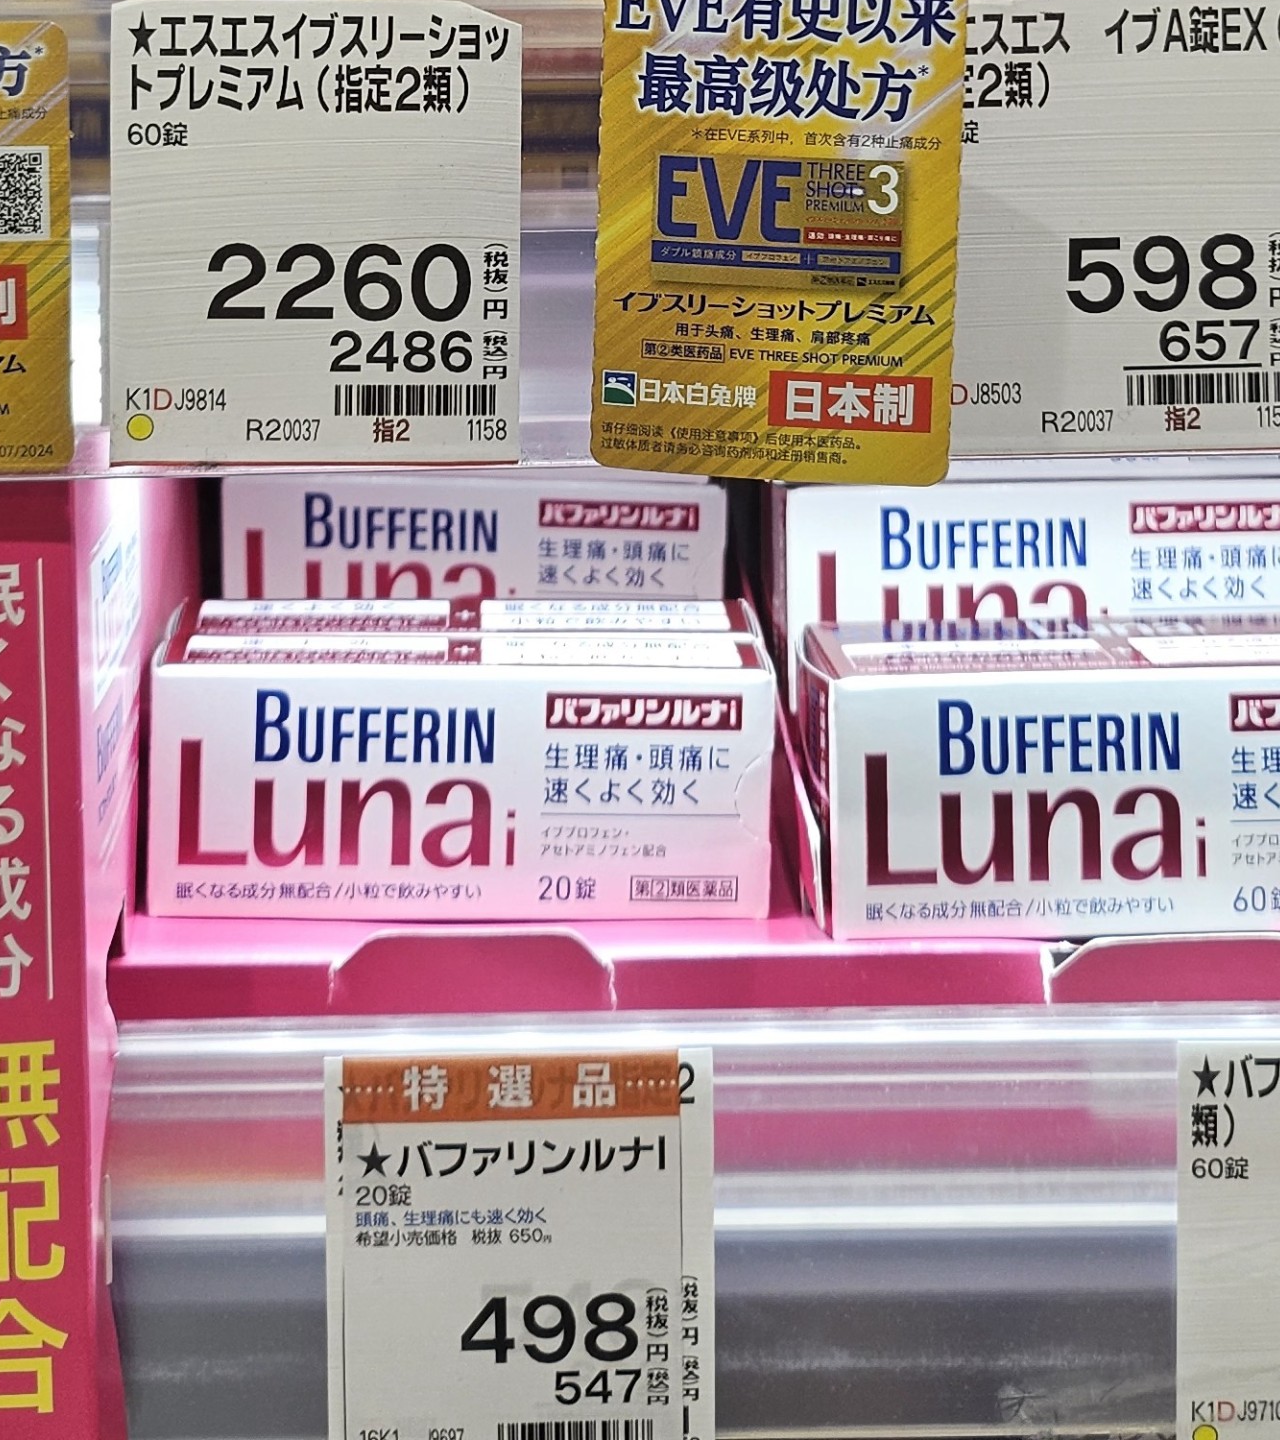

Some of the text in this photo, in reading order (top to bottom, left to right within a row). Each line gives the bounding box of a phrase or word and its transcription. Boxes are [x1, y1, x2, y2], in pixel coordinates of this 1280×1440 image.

[127, 123, 189, 147] 60錠
[207, 242, 472, 323] 2260
[1066, 233, 1258, 313] 598
[329, 330, 473, 373] 2486
[1159, 319, 1261, 362] 657
[730, 348, 903, 368] EVE THREE SHOT PREMIUM
[785, 380, 914, 427] 日本制
[544, 744, 731, 772] 生理痛・頭痛に
[543, 777, 702, 807] 速くよく効く
[538, 875, 596, 902] 20錠
[1191, 1157, 1249, 1180] 60錠
[356, 1184, 412, 1208] 20錠
[356, 1230, 458, 1247] 希望小売価格
[461, 1293, 639, 1364] 498
[555, 1369, 642, 1405] 547
